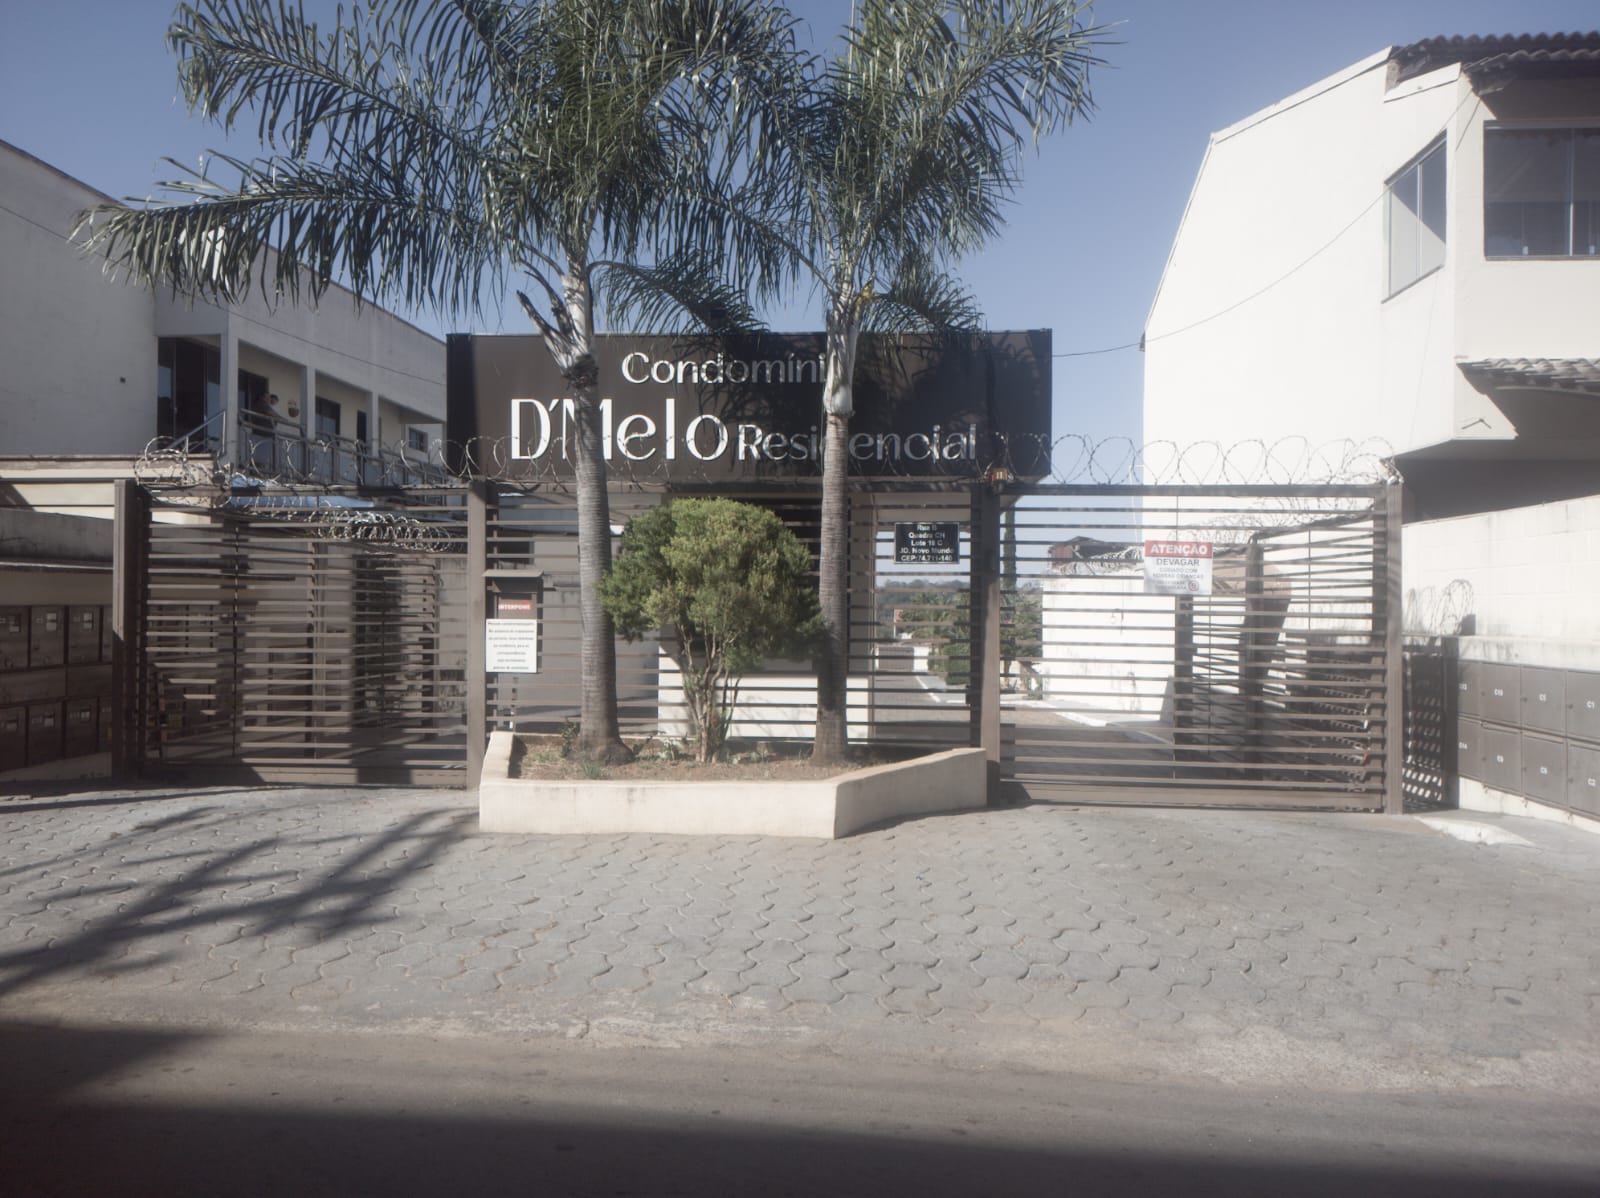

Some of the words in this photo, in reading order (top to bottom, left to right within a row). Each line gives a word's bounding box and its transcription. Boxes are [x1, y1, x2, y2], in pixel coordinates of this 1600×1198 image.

[621, 351, 826, 384] Condomíni
[738, 423, 977, 461] Resiencial
[908, 531, 933, 539] Quadra
[1150, 542, 1208, 556] ATENÇÃO
[1156, 558, 1200, 566] DEVAGAR
